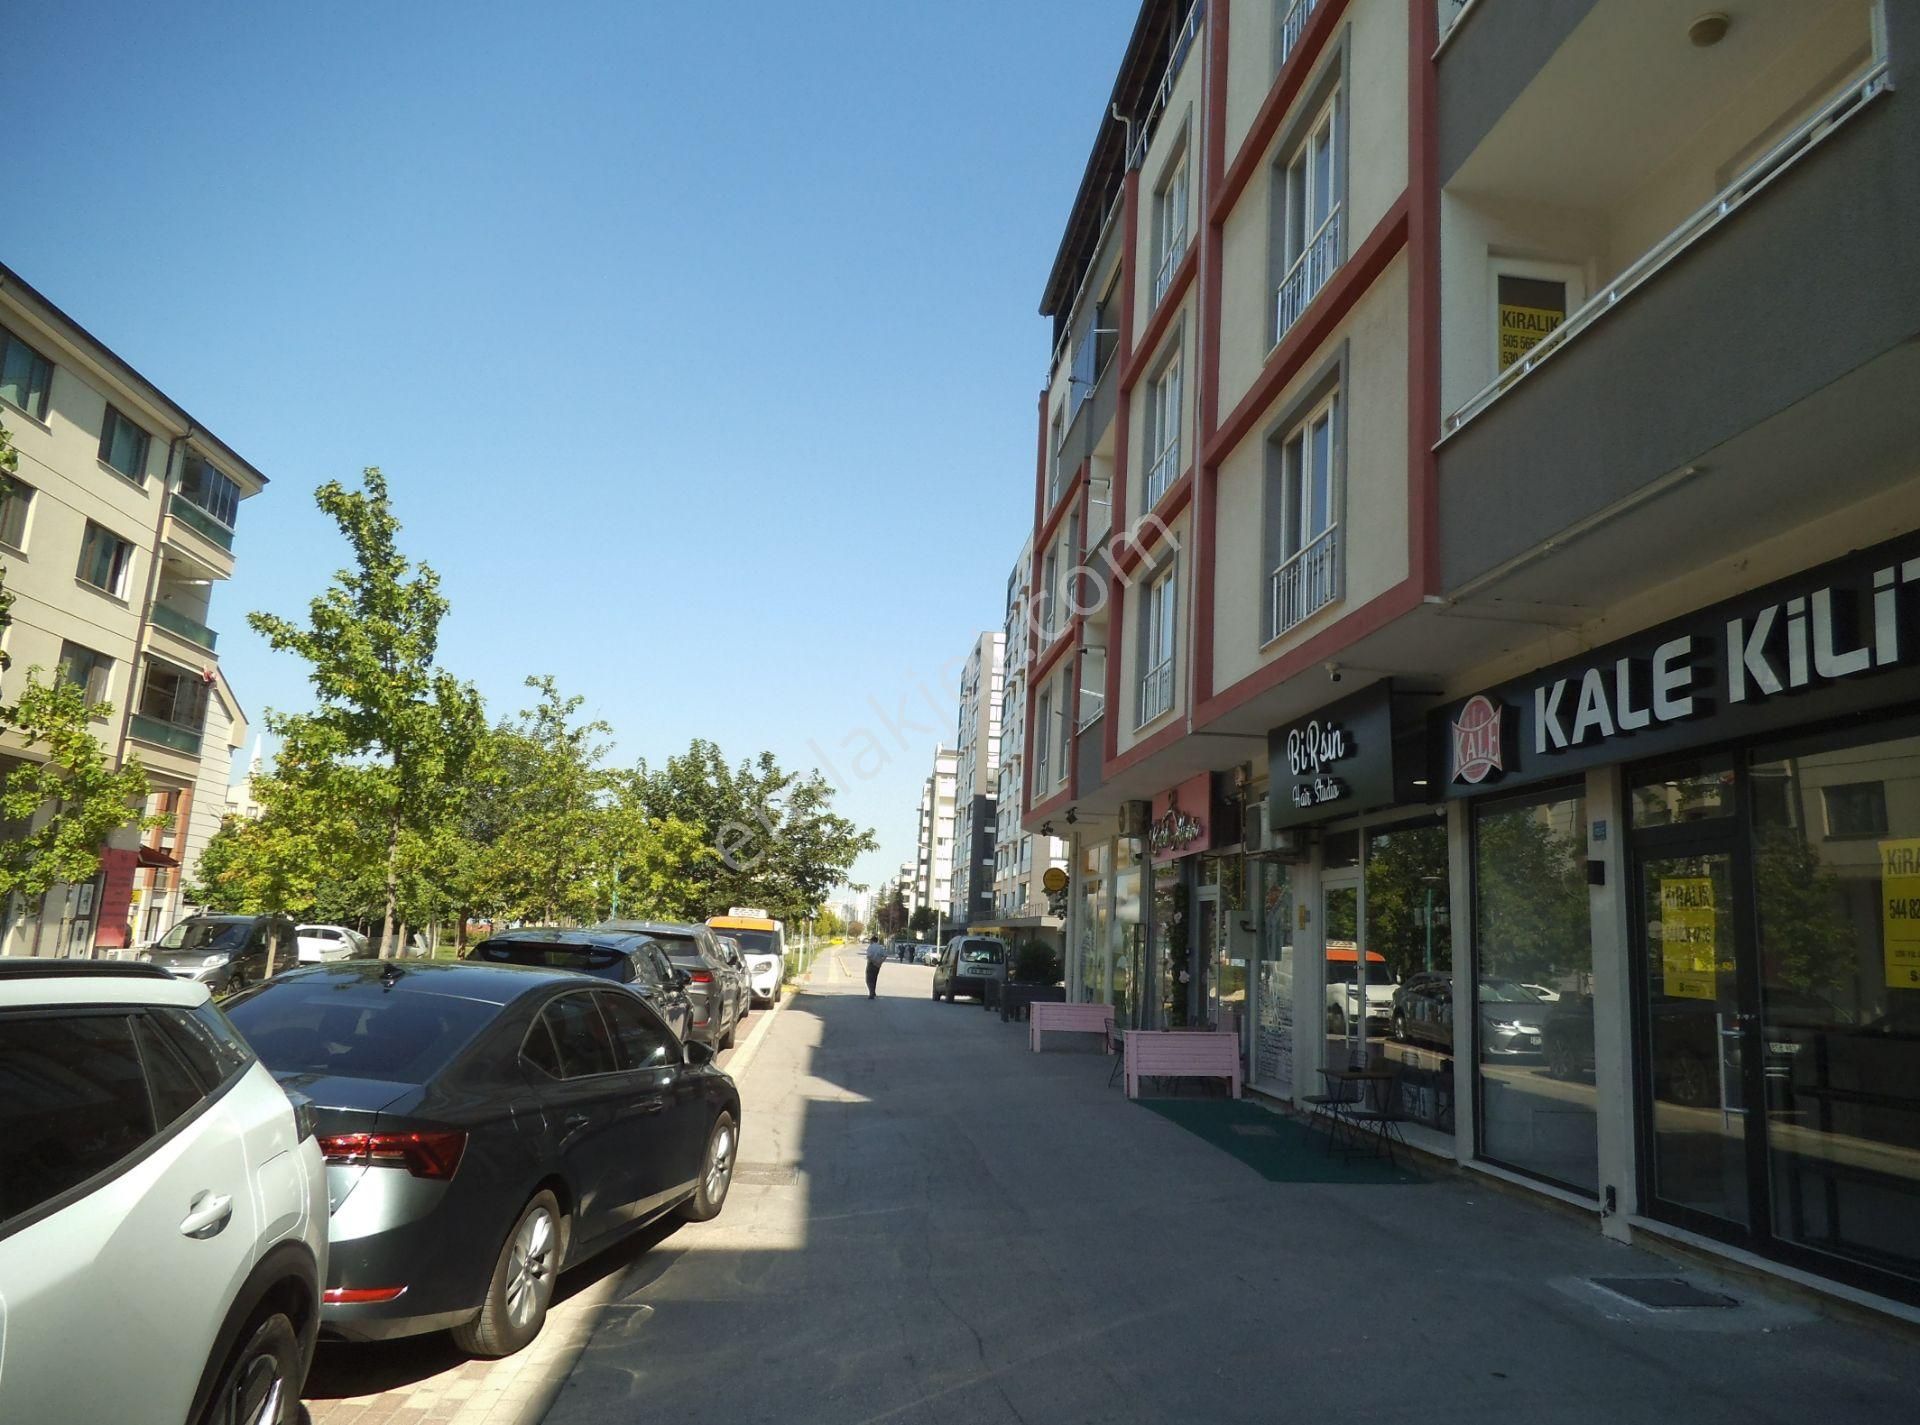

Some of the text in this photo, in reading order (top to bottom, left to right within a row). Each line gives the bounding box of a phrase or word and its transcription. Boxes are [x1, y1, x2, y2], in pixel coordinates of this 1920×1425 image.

[1535, 634, 1693, 754] KALE
[1454, 716, 1498, 773] KALE
[1291, 776, 1340, 809] Hair Studio
[1889, 899, 1906, 920] 544
